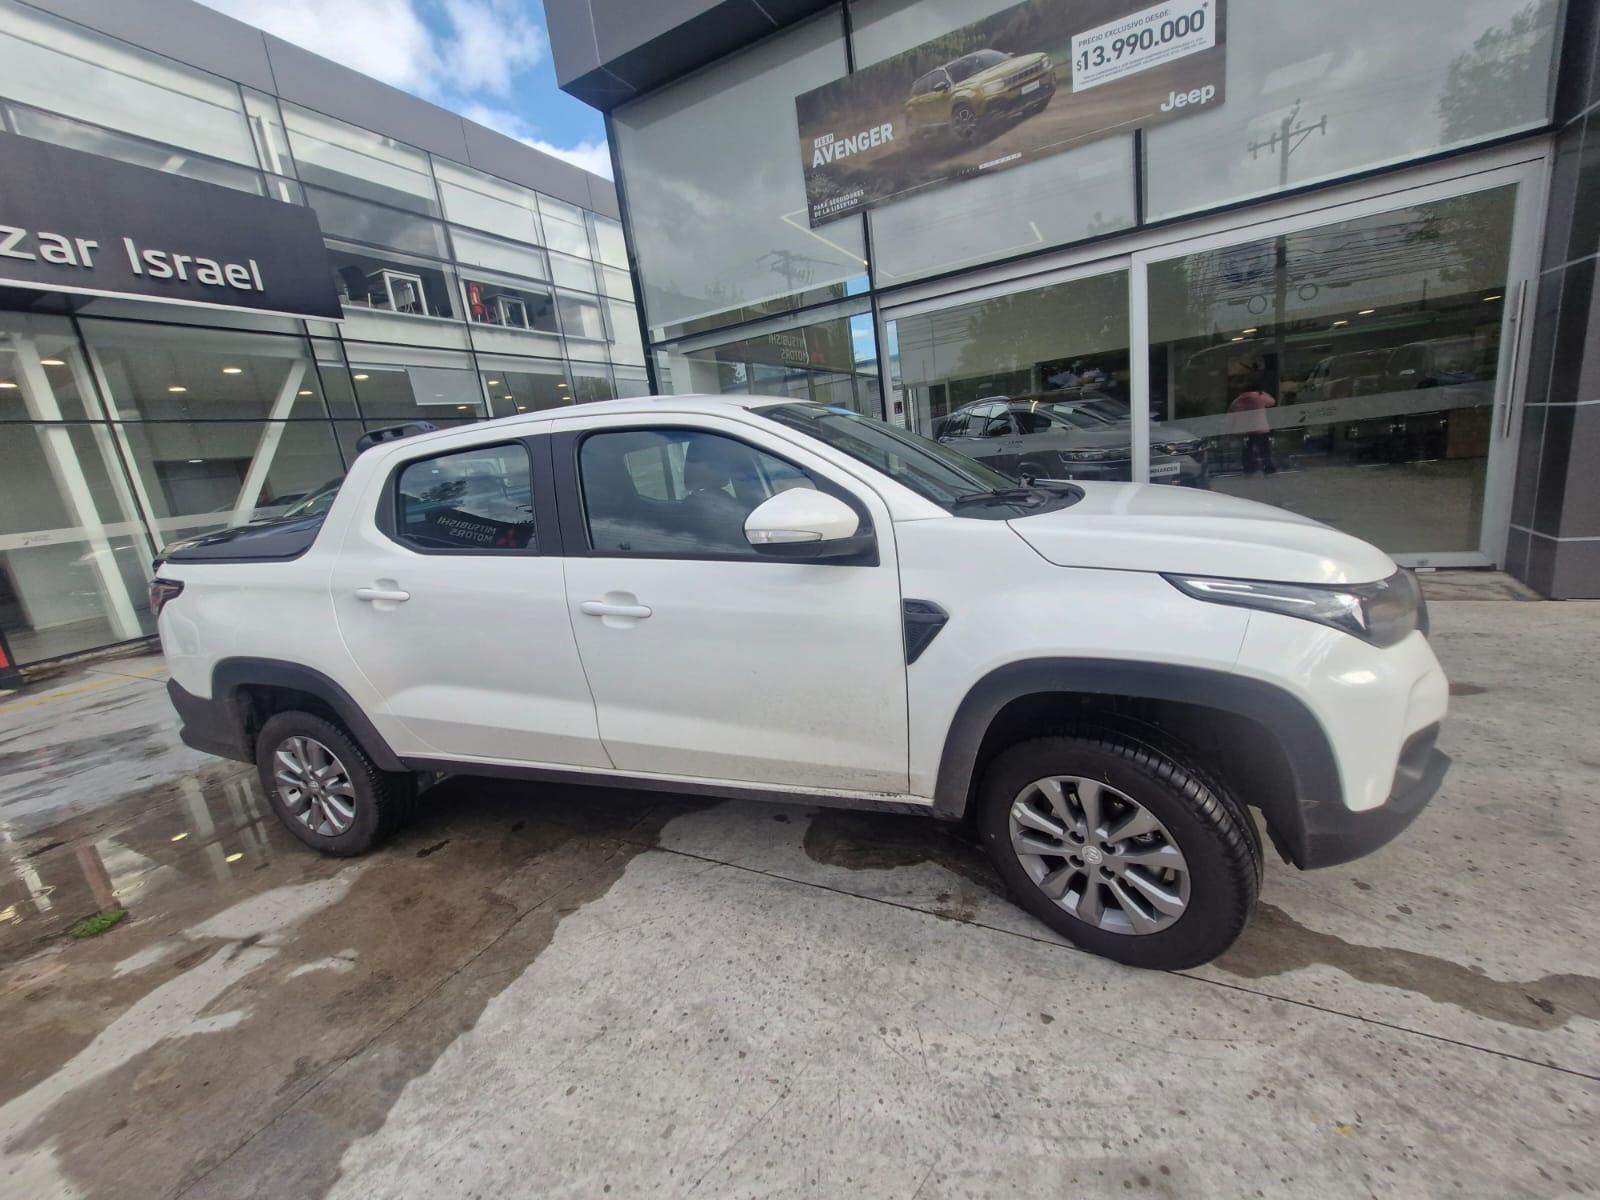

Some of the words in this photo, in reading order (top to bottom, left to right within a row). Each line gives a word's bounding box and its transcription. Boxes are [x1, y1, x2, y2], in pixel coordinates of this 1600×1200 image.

[1078, 32, 1104, 48] PRECIO
[1104, 19, 1144, 38] EXCLUSIVO
[1160, 84, 1215, 112] Jeep
[812, 123, 894, 168] AVENGER
[123, 237, 264, 292] Israel
